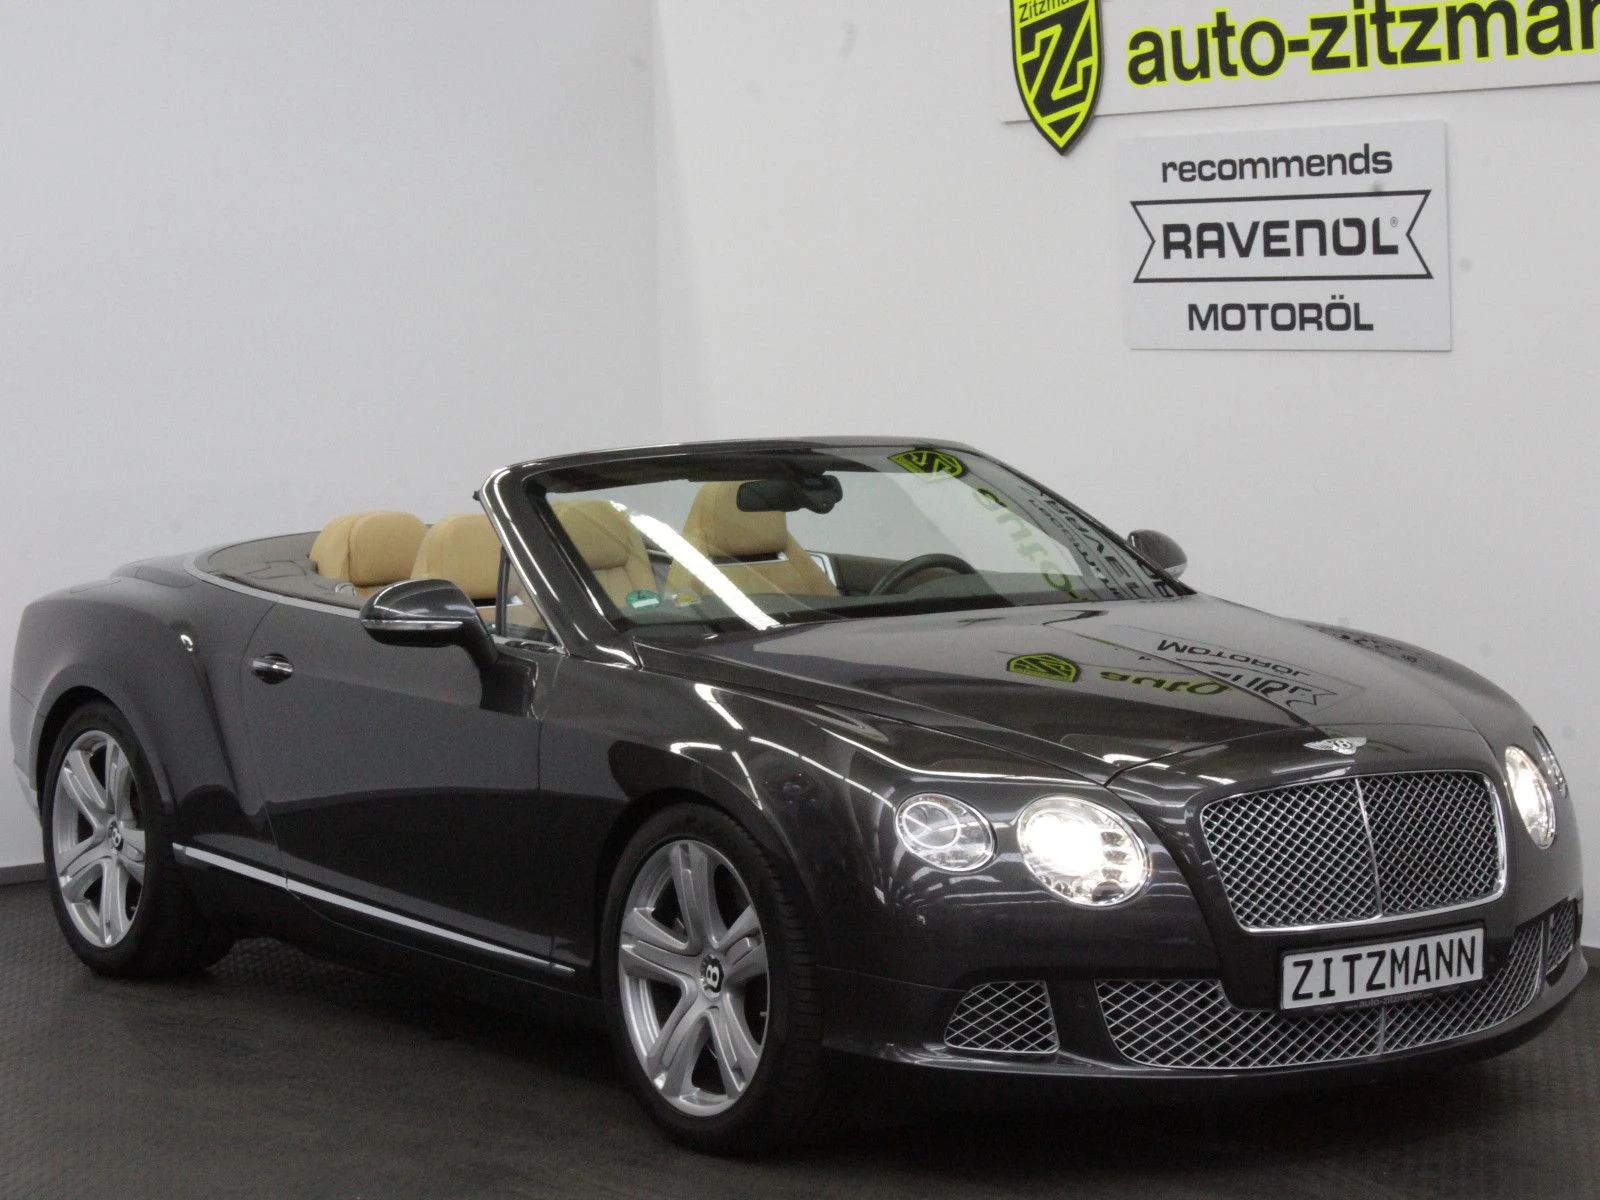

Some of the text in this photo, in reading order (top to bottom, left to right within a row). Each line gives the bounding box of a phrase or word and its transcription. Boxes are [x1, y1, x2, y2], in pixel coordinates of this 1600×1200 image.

[1161, 143, 1393, 183] recommends
[1187, 294, 1375, 332] MOTORÖL
[1291, 935, 1476, 1001] ZITZMANN
